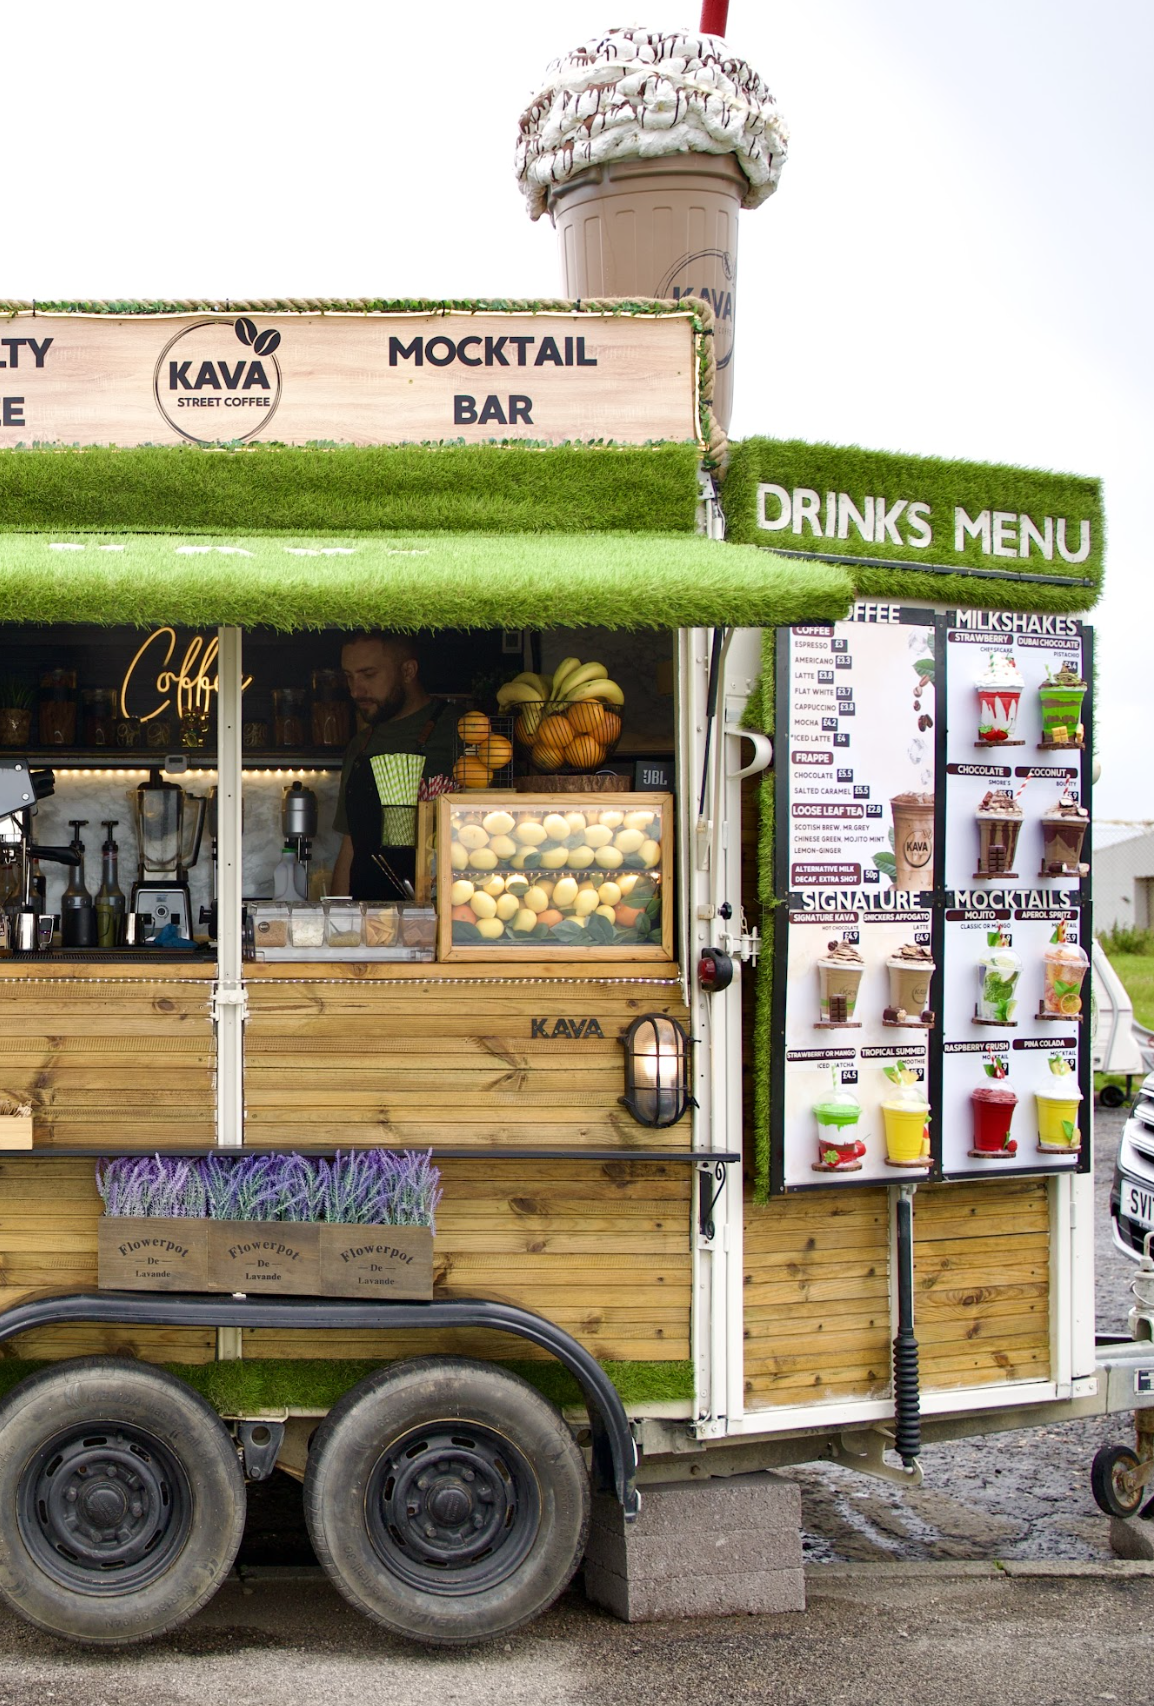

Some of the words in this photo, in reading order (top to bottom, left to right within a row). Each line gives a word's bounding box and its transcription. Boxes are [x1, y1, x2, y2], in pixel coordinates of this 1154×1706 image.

[388, 336, 597, 367] MOCKTAIL
[169, 360, 271, 390] KAVA
[177, 397, 222, 407] STREET
[224, 397, 271, 407] COFFEE
[454, 394, 534, 425] BAR
[757, 482, 932, 548] DRINKS
[954, 507, 1091, 563] MENU
[956, 609, 1077, 636] MILKSHAKES
[796, 627, 830, 635] COFFEE
[955, 633, 1009, 643] STRAWBERRY
[795, 641, 828, 649] ESPRESSO
[835, 640, 843, 648] £3
[1018, 637, 1039, 646] DUBAI
[1040, 639, 1079, 649] CHOCOLATE
[795, 657, 834, 665] AMERICANO
[837, 656, 851, 664] £3.3
[121, 627, 254, 723] Coff
[819, 671, 833, 680] £3.8
[812, 688, 834, 696] WHITE
[837, 687, 851, 696] £3.7
[795, 703, 836, 711] CAPPUCCINO
[840, 703, 854, 711] £3.8
[823, 718, 837, 727] £4.2
[837, 734, 846, 742] £4
[796, 753, 830, 763] FRAPPE
[838, 770, 852, 778] £5.5
[958, 765, 1004, 776] CHOCOLATE
[1030, 768, 1067, 777] COCONUT
[643, 769, 667, 785] JBL
[793, 806, 822, 815] LOOSE
[823, 806, 845, 816] LEAF
[846, 806, 863, 816] TEA
[906, 842, 928, 851] KAVA
[865, 870, 878, 880] 50p
[802, 891, 921, 910] SIGNATURE
[954, 890, 1071, 909] MOCKTAILS
[793, 913, 834, 922] SIGNATURE
[864, 913, 895, 921] SNICKERS
[965, 911, 996, 919] MOJITO
[1021, 911, 1048, 919] APEROL
[844, 931, 858, 940] £4.9
[916, 933, 929, 942] £4.9
[531, 1018, 605, 1039] KAVA
[861, 1048, 895, 1056] TROPICAL
[896, 1047, 925, 1055] SUMMER
[944, 1043, 985, 1052] RASPBERRY
[787, 1051, 825, 1059] STRAWBERRY
[842, 1071, 857, 1080] £4.5
[117, 1237, 191, 1258] Flowerpot
[227, 1240, 302, 1261] Flowerpot
[339, 1243, 415, 1265] Flowerpot
[147, 1257, 160, 1265] De
[257, 1259, 270, 1268] De
[370, 1264, 383, 1272] De
[135, 1270, 171, 1278] Lavande
[245, 1272, 282, 1281] Lavande
[357, 1277, 395, 1286] Lavande
